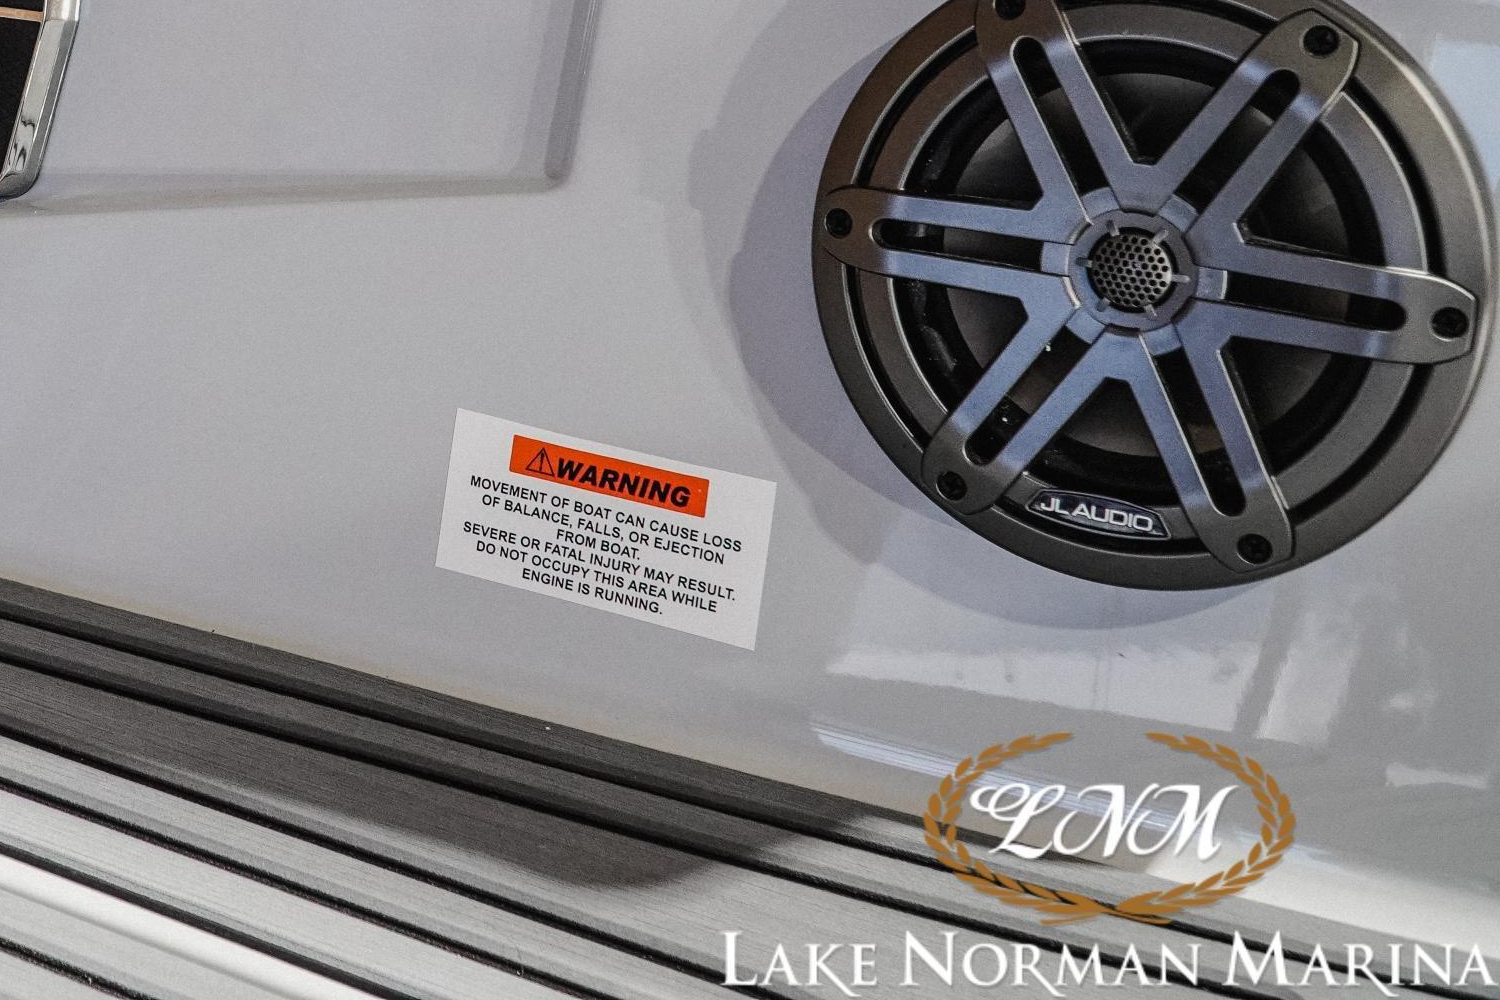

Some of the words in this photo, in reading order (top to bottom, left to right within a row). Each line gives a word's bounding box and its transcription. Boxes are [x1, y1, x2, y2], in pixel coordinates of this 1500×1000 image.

[557, 458, 691, 508] WARNING
[470, 475, 545, 505] MOVEMENT
[551, 495, 570, 509] OF
[574, 501, 612, 520] BOAT
[615, 511, 645, 528] CAN
[650, 519, 699, 542] CAUSE
[703, 532, 742, 552] LOSS
[482, 494, 500, 508] OF
[504, 500, 572, 528] BALANCE,
[578, 518, 624, 540] FALLS,
[629, 531, 649, 545] OR
[654, 536, 724, 564] EJECTION
[1041, 497, 1070, 517] JL
[1071, 500, 1154, 532] AUDIO
[463, 521, 517, 543] SEVERE
[520, 535, 540, 549] OR
[544, 540, 586, 561] FATAL
[590, 552, 641, 575] INJURY
[644, 566, 674, 583] MAY
[678, 575, 735, 600] RESULT.
[556, 529, 596, 549] FROM
[601, 540, 640, 560] BOAT.
[476, 540, 496, 555] DO
[499, 546, 528, 563] NOT
[532, 555, 590, 579] OCCUPY
[593, 571, 625, 588] THIS
[628, 580, 667, 600] AREA
[672, 590, 717, 612] WHILE
[522, 568, 573, 590] ENGINE
[578, 582, 590, 595] IS
[595, 586, 662, 615] RUNNING.
